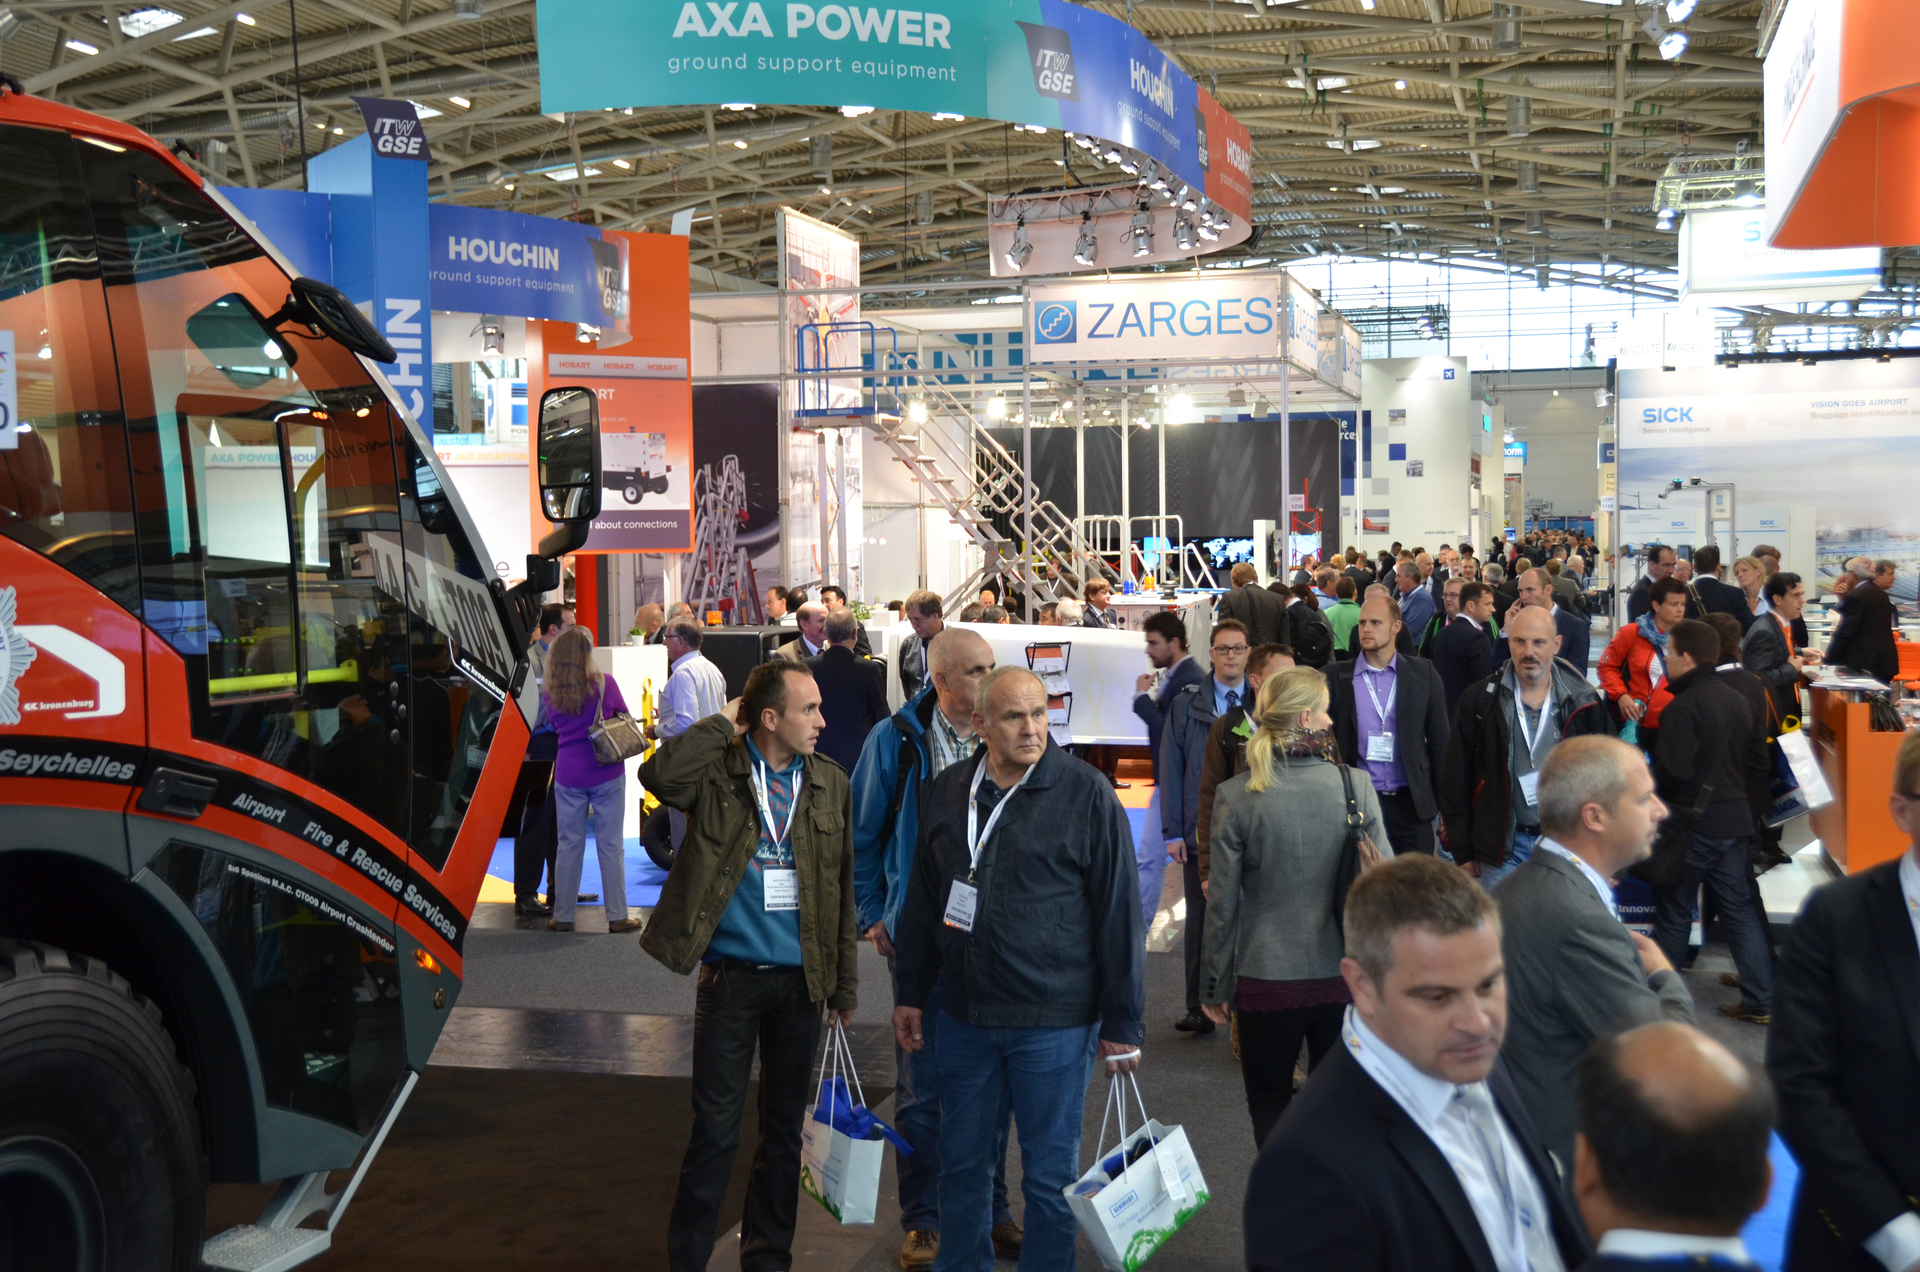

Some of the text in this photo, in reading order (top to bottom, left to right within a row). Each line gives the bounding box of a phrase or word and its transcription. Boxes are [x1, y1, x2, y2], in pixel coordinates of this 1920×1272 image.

[672, 2, 951, 49] AXA POWER
[668, 53, 956, 82] ground support equipment
[1036, 49, 1069, 72] ITW
[1038, 70, 1074, 94] GSE
[1130, 58, 1174, 119] HOUCHIN
[374, 118, 416, 136] ITW
[1117, 101, 1143, 121] ground
[1143, 113, 1162, 136] support
[377, 135, 422, 154] GSE
[449, 237, 559, 271] HOUCHIN
[476, 271, 521, 288] support
[525, 279, 574, 294] equipment
[603, 288, 622, 310] GSE
[1087, 297, 1273, 339] ZARGES
[559, 361, 591, 369] HOBART
[603, 362, 635, 370] HOBART
[1868, 398, 1908, 406] AIRPORT
[1642, 407, 1694, 423] SICK
[1810, 411, 1849, 419] Baggage
[1850, 409, 1909, 417] identification
[211, 453, 235, 463] AXA
[477, 452, 528, 461] AVIATION
[595, 521, 622, 530] about
[624, 520, 678, 529] connections
[471, 665, 506, 700] kronenburg
[40, 700, 94, 710] kronenburg
[0, 749, 136, 779] Seychelles
[232, 792, 458, 940] Airport Fire & Rescue Services
[228, 864, 239, 873] 6x6
[241, 867, 271, 885] Spacious
[271, 878, 294, 895] M.A.C.
[295, 889, 319, 907] CT009
[320, 901, 346, 922] Airport
